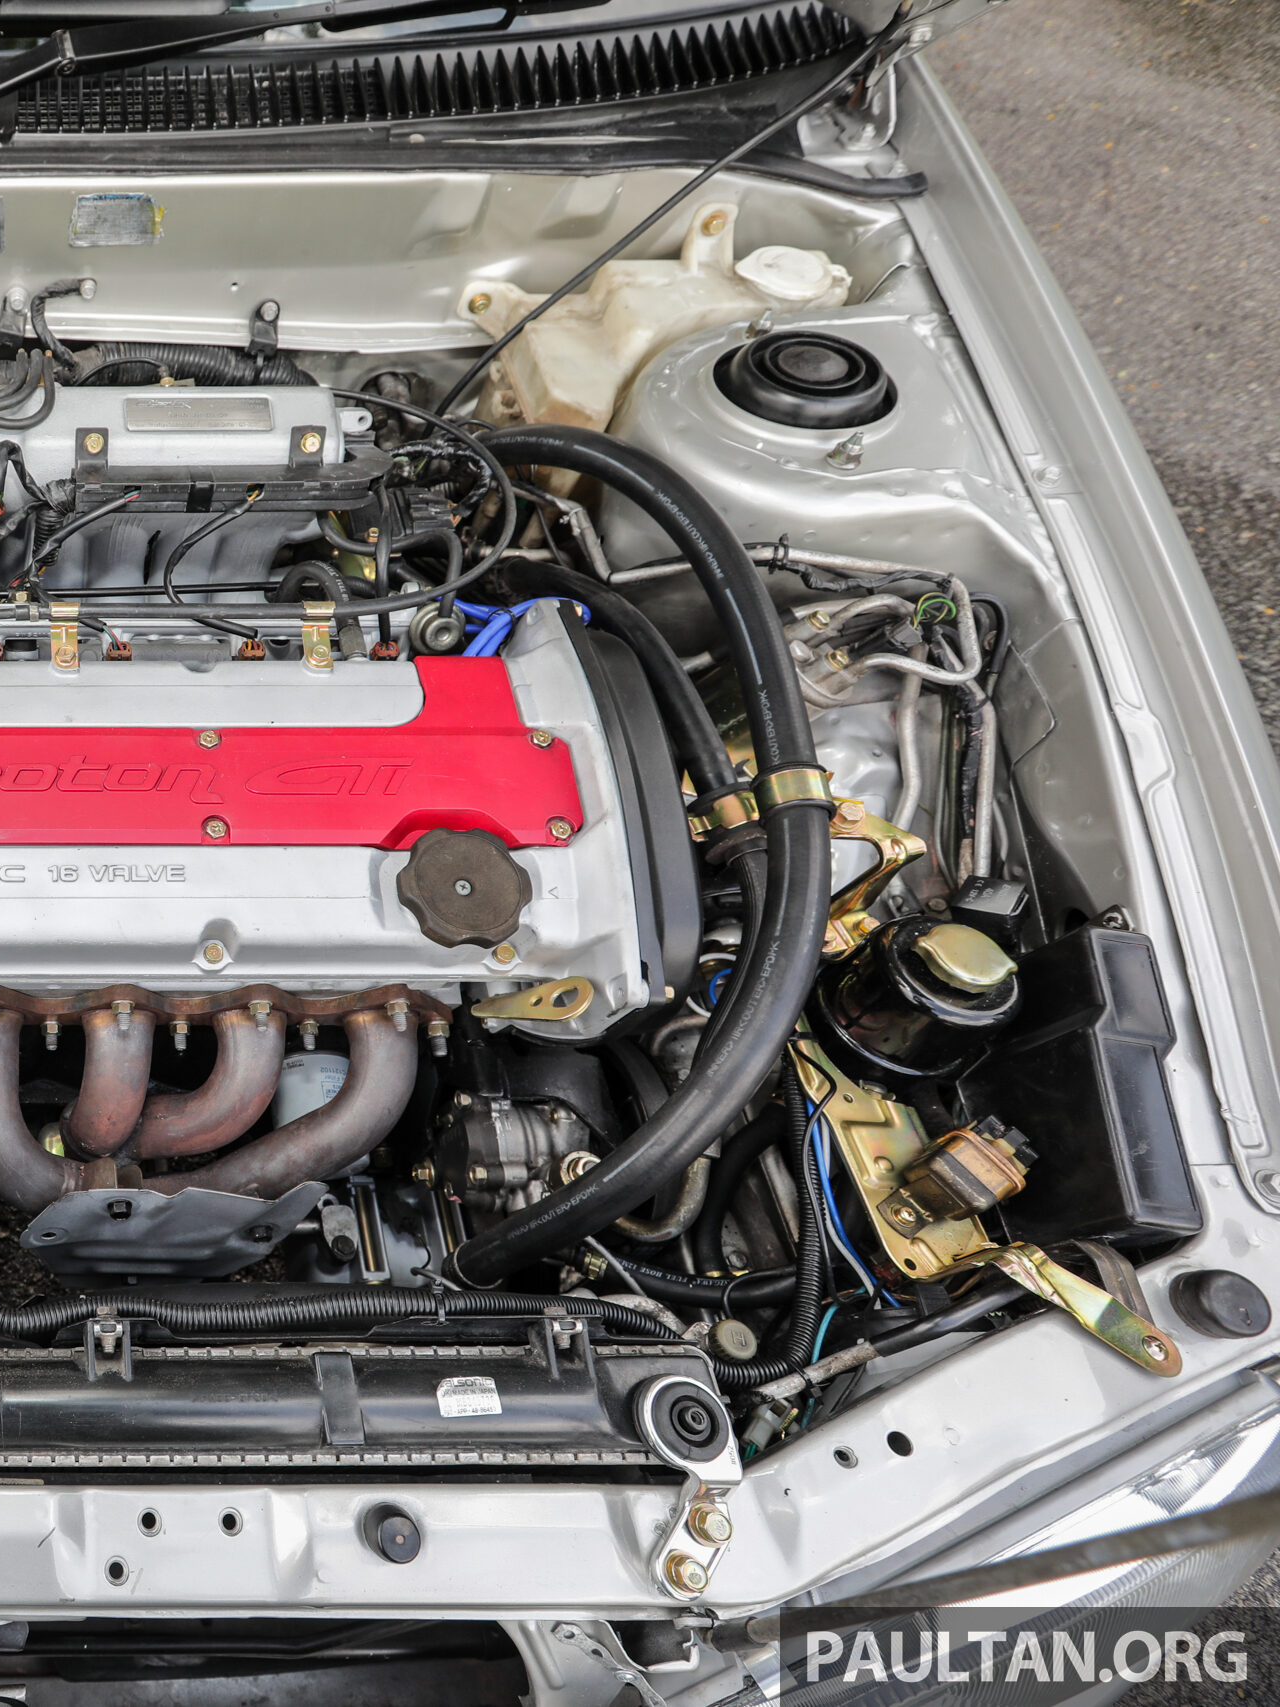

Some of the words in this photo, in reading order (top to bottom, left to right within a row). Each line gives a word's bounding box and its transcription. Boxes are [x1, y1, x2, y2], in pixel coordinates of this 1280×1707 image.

[48, 864, 80, 883] 16
[88, 864, 187, 883] VALVE
[639, 1266, 662, 1277] HOSE
[665, 1272, 688, 1282] FUEL
